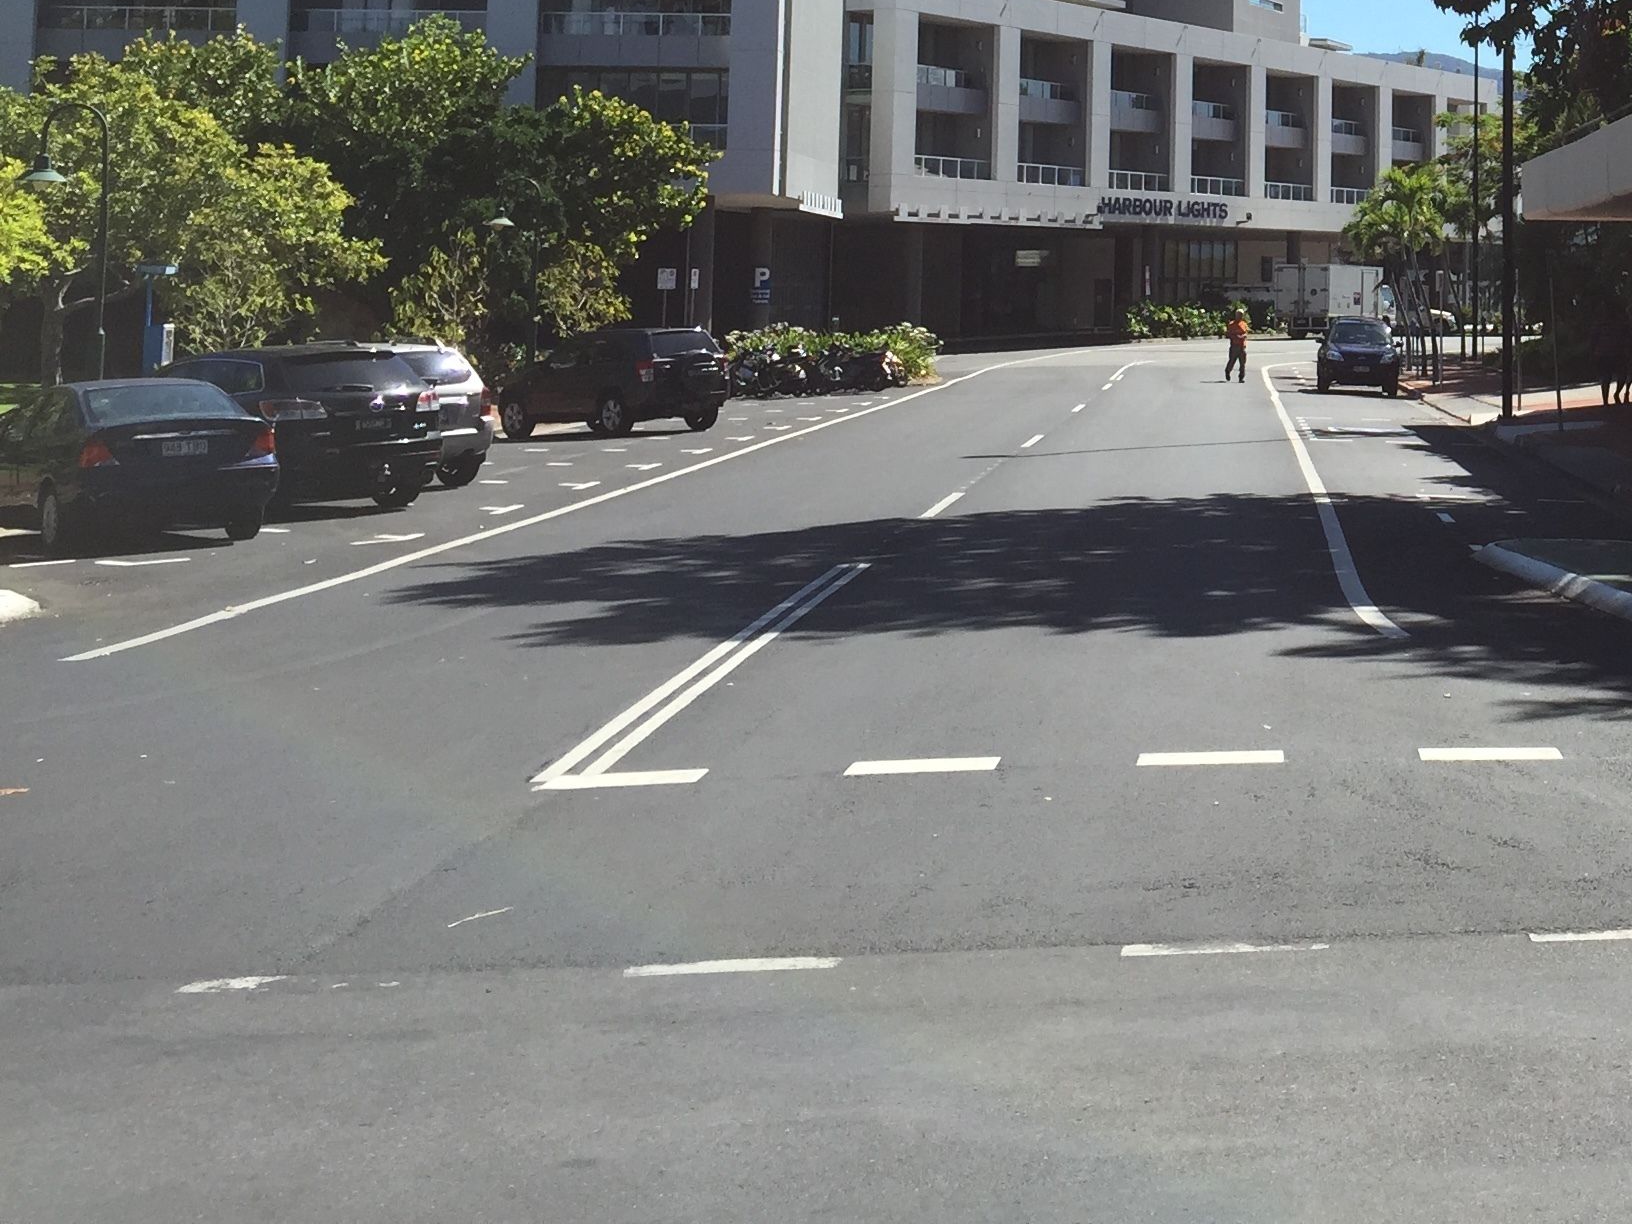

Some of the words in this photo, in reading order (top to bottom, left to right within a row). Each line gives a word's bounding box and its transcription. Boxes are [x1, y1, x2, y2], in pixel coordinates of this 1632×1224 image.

[1101, 196, 1174, 217] HARBOUR
[1178, 200, 1228, 220] LIGHTS
[754, 267, 771, 287] P
